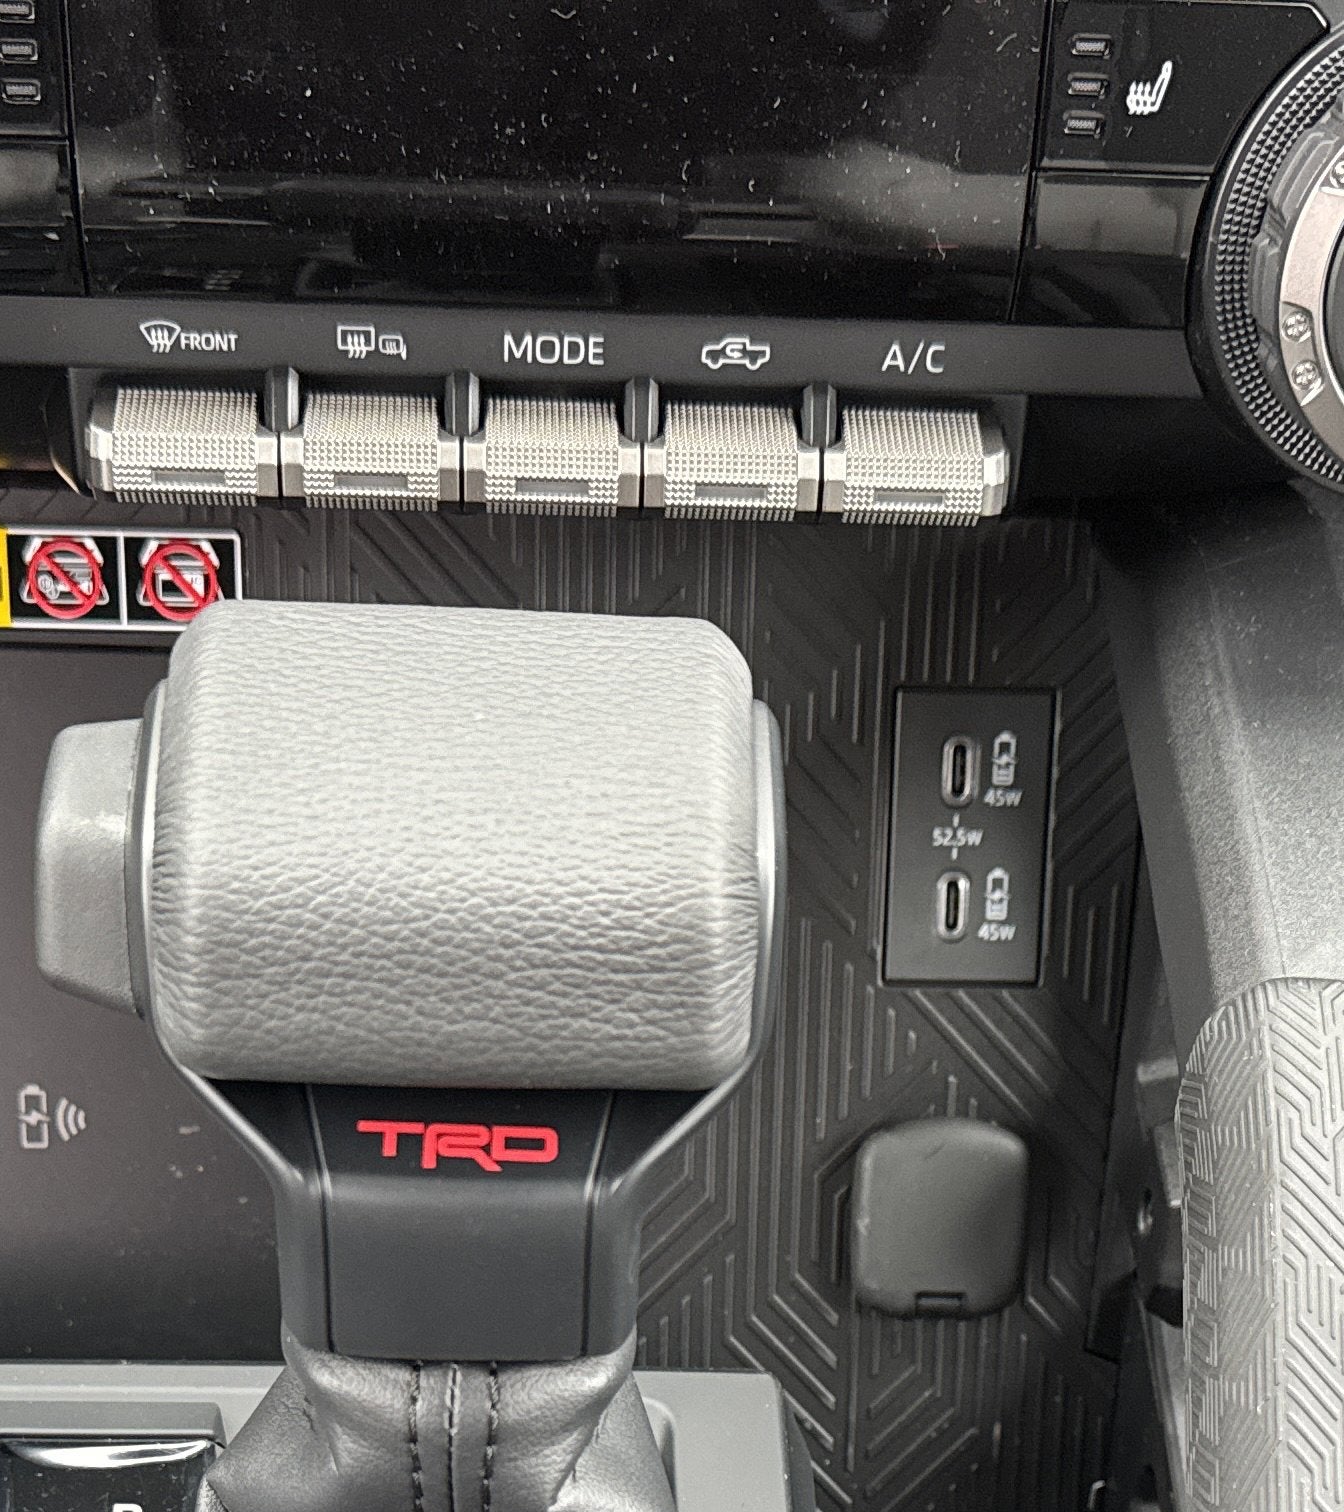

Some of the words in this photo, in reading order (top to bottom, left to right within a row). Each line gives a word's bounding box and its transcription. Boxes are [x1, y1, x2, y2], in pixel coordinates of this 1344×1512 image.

[178, 330, 238, 353] FRONT
[503, 332, 605, 366] MODE
[881, 341, 946, 375] A/C
[983, 788, 1023, 807] 45W
[931, 826, 984, 848] 52.5W
[977, 923, 1017, 941] 45W
[356, 1120, 559, 1172] TRD
